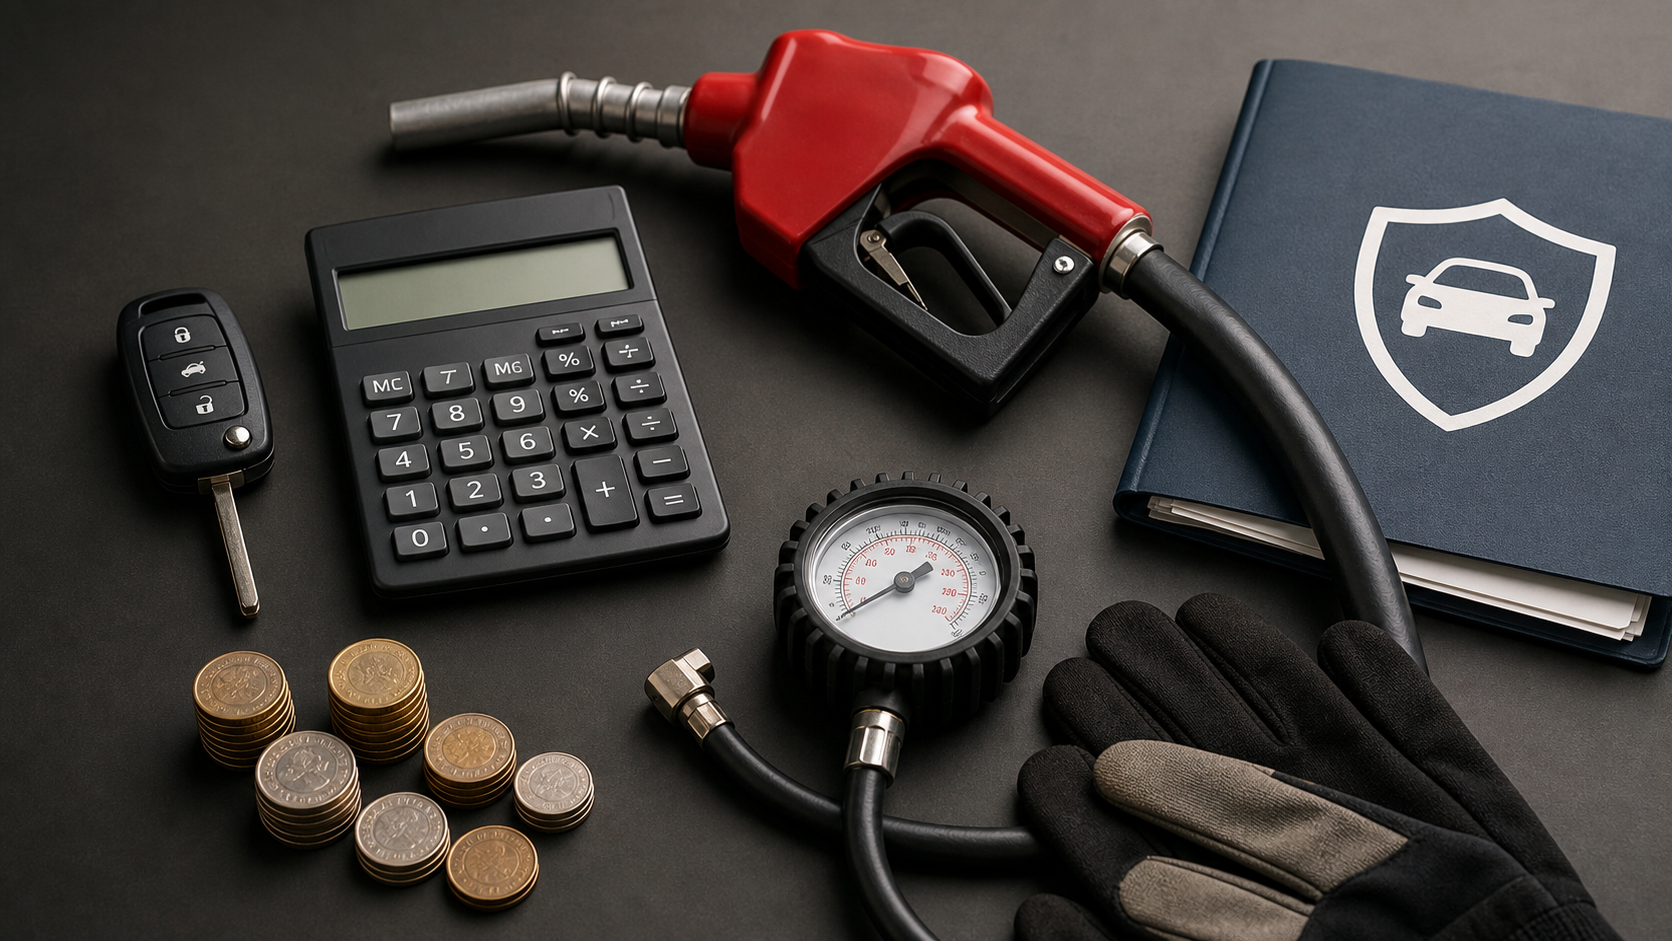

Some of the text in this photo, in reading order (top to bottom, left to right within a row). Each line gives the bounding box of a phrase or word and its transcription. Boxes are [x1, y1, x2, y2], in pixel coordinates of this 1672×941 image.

[373, 377, 402, 394] MC
[510, 396, 526, 413] 9
[449, 405, 465, 422] 8
[386, 414, 402, 431] 7
[520, 433, 536, 450] 6
[458, 442, 474, 459] 5
[395, 451, 412, 468] 4
[530, 472, 546, 489] 3
[467, 481, 484, 499] 2
[405, 490, 417, 508] 1
[412, 529, 429, 547] 0
